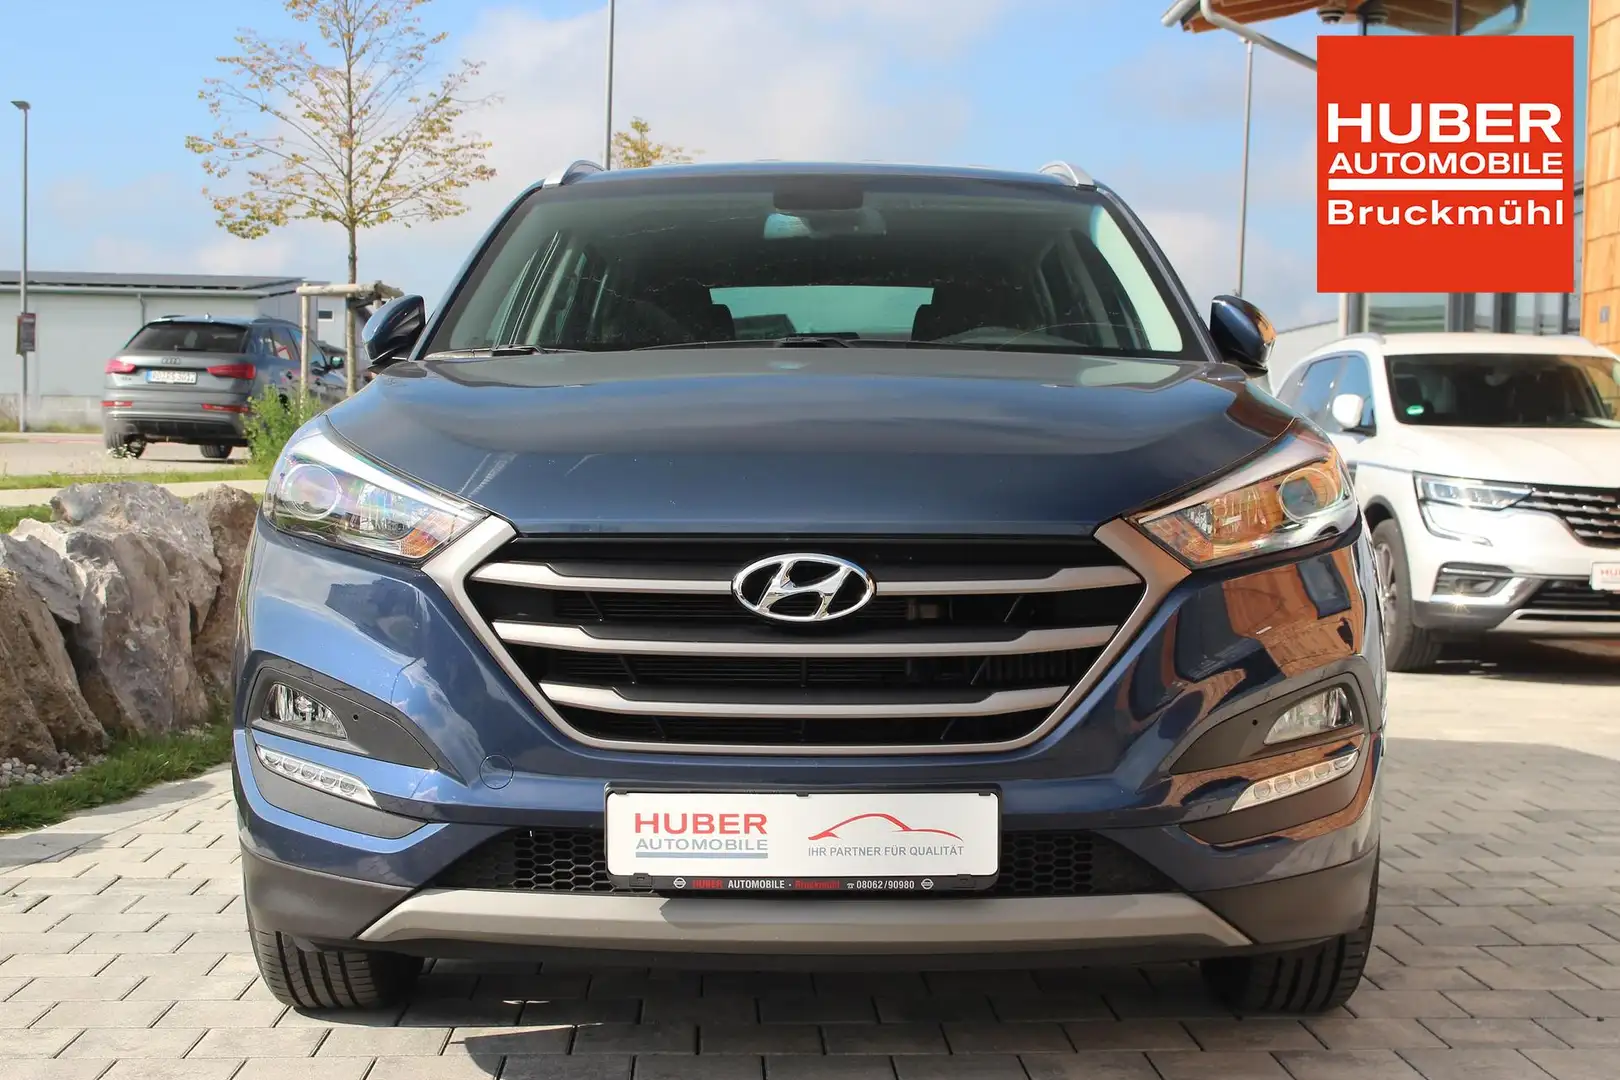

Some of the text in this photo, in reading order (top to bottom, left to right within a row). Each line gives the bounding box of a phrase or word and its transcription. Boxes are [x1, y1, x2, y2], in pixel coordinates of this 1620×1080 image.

[634, 813, 767, 835] HUBER
[635, 837, 768, 852] AUTOMOBILE
[808, 845, 964, 857] IHR PARTNER FÜR QUALITÄT
[727, 879, 785, 889] AUTOMOBILE
[856, 880, 915, 889] 08062/90980
